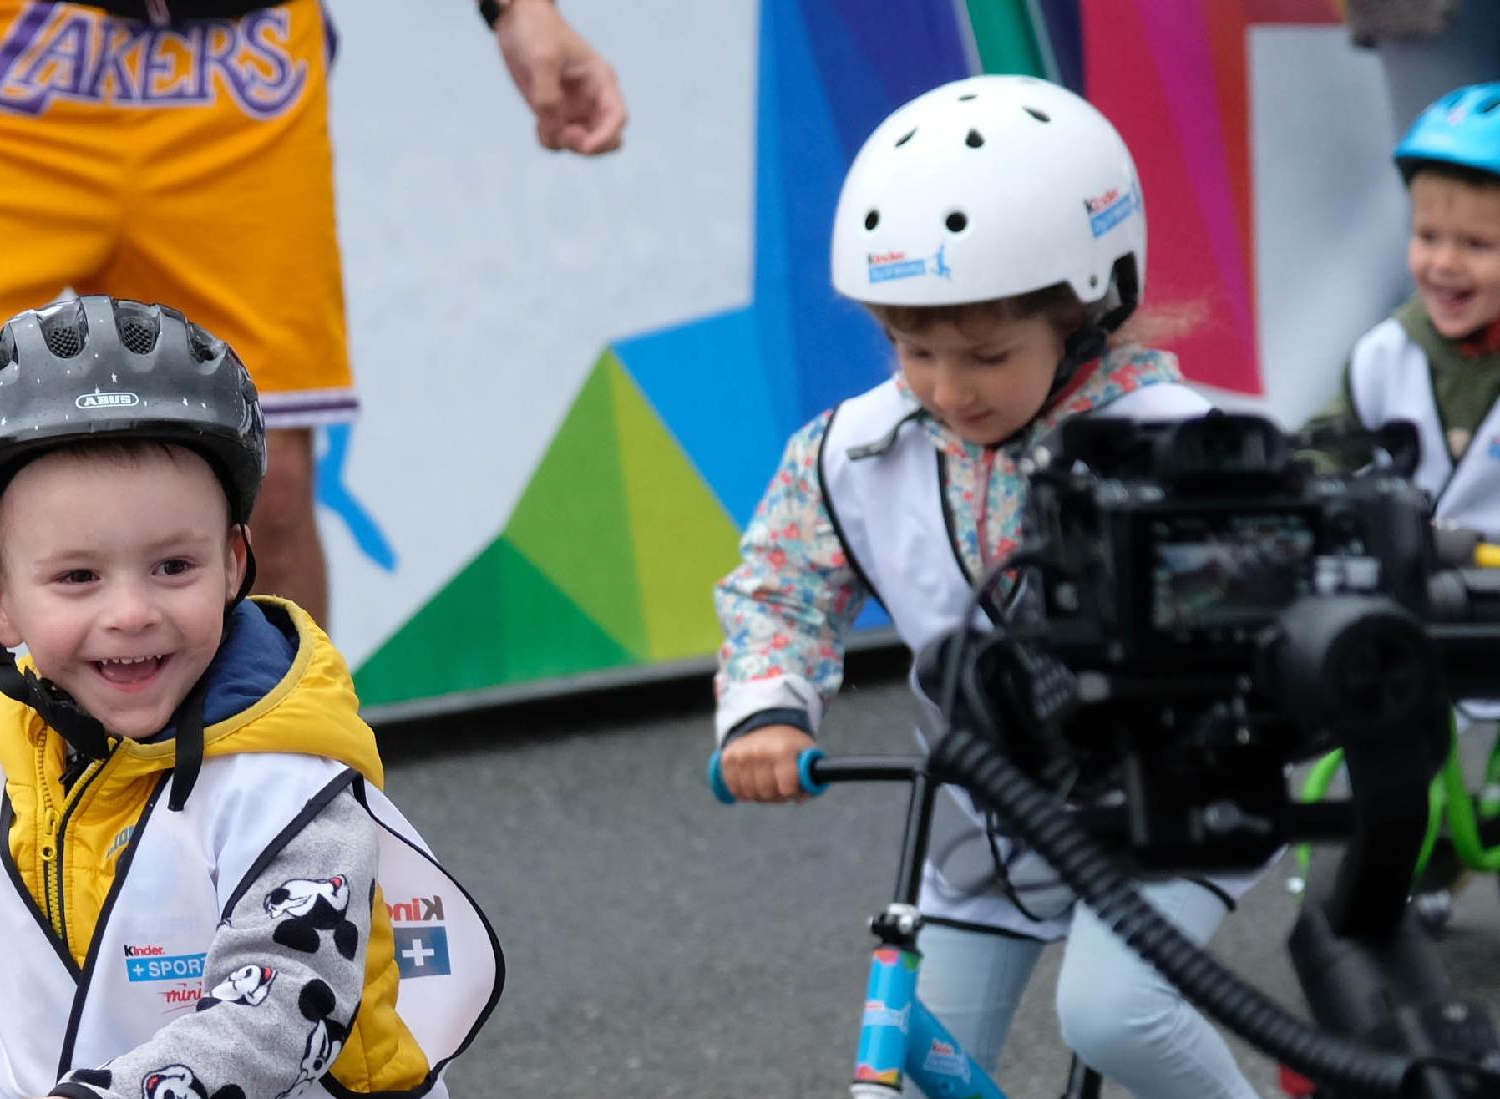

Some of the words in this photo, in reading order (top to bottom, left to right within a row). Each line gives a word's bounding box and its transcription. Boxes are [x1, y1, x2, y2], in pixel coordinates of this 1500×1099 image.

[83, 395, 131, 407] ABUS
[148, 958, 205, 977] SPOR
[160, 982, 203, 1003] mini
